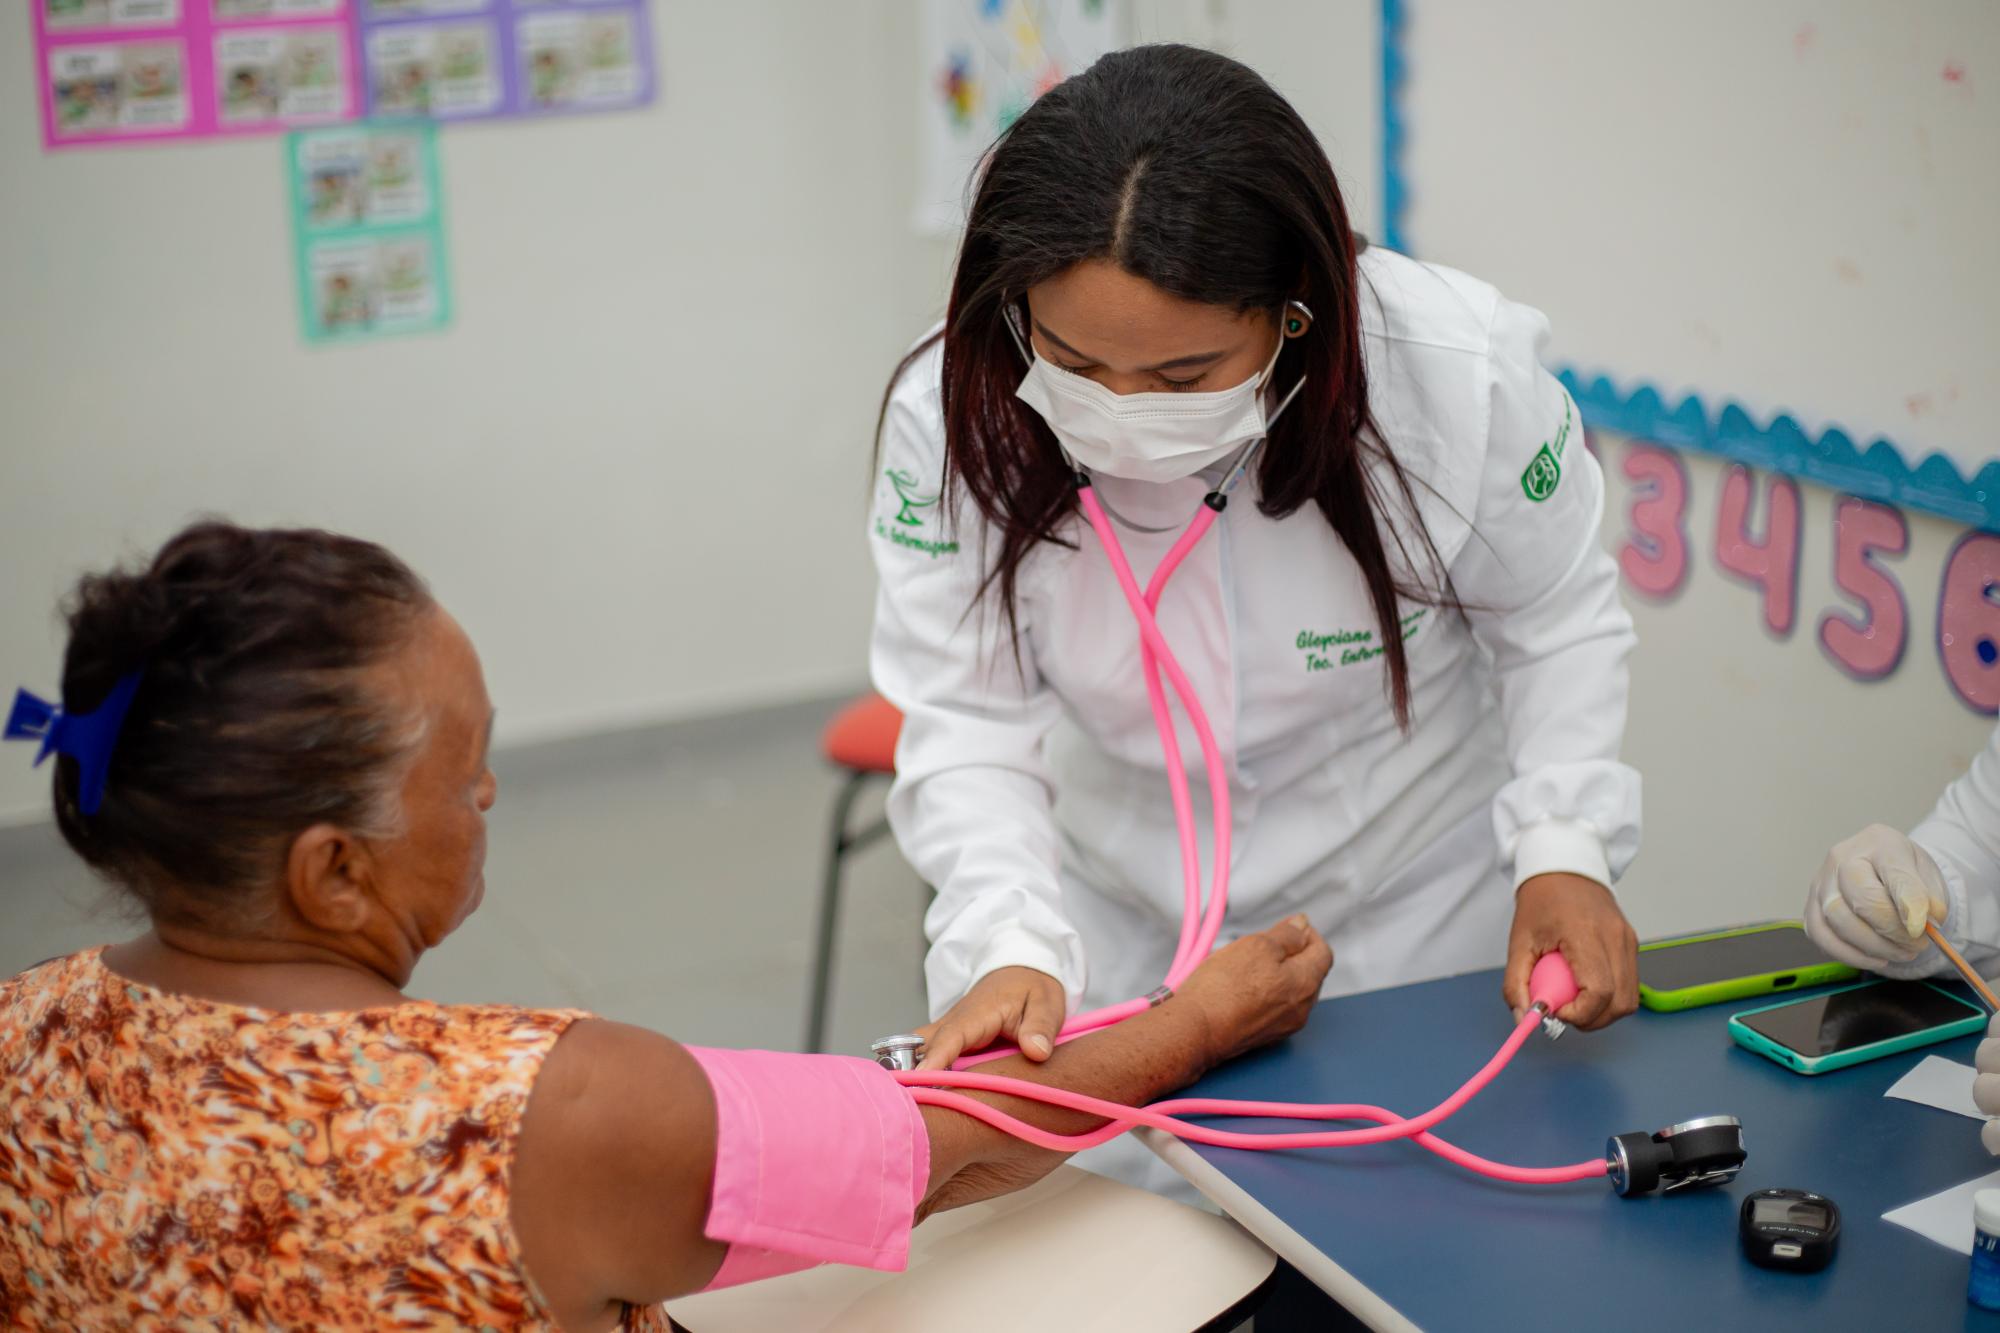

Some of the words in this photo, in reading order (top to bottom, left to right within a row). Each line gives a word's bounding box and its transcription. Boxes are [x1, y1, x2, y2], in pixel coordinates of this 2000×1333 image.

[1620, 441, 1688, 600] 3
[1715, 462, 1802, 639] 4
[1819, 494, 1908, 682] 5
